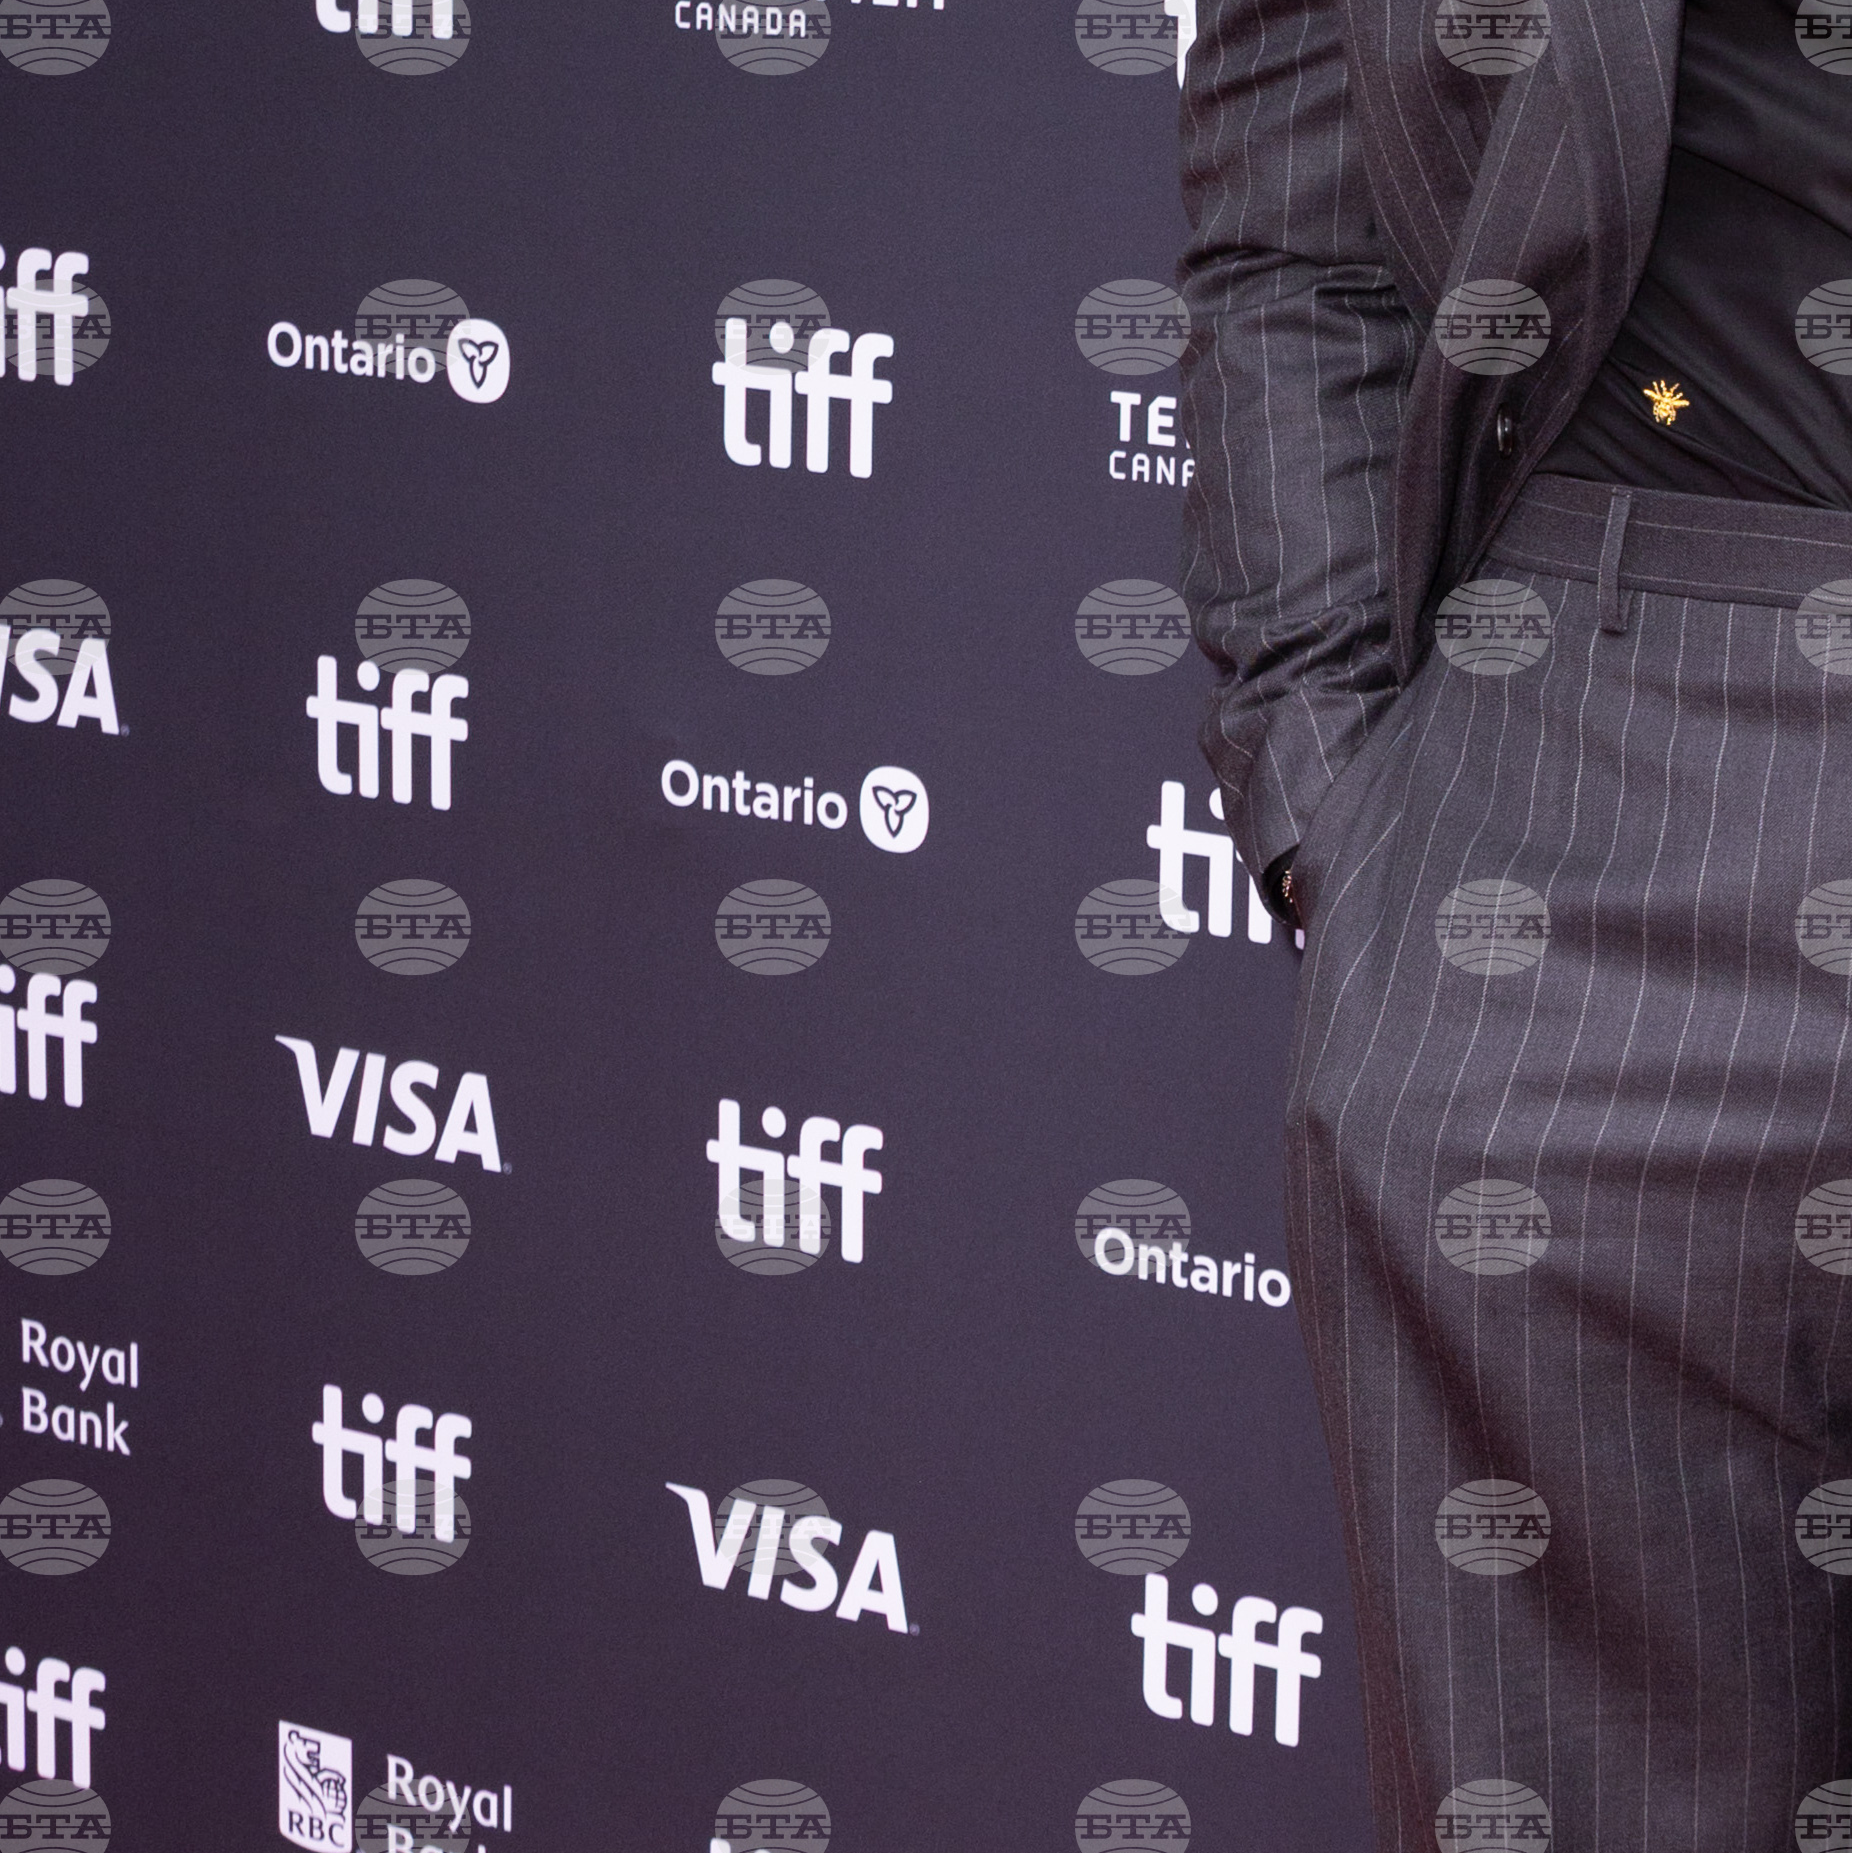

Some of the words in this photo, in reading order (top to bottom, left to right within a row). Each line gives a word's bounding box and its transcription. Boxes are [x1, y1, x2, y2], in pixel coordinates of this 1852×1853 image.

[676, 1, 805, 37] CANADA
[268, 322, 435, 382] Ontario
[712, 318, 894, 478] tiff
[0, 625, 119, 734] SA
[307, 656, 468, 810] tiff
[662, 760, 847, 829] Ontario
[276, 1036, 501, 1172] VISA
[707, 1099, 883, 1263] tiff
[1095, 1228, 1290, 1306] Ontario
[22, 1320, 137, 1390] Royal
[23, 1388, 129, 1454] Bank
[313, 1385, 471, 1542] tiff
[666, 1483, 907, 1633] VISA
[1131, 1573, 1322, 1746] tiff
[288, 1811, 346, 1849] RBC
[388, 1756, 511, 1832] Royal
